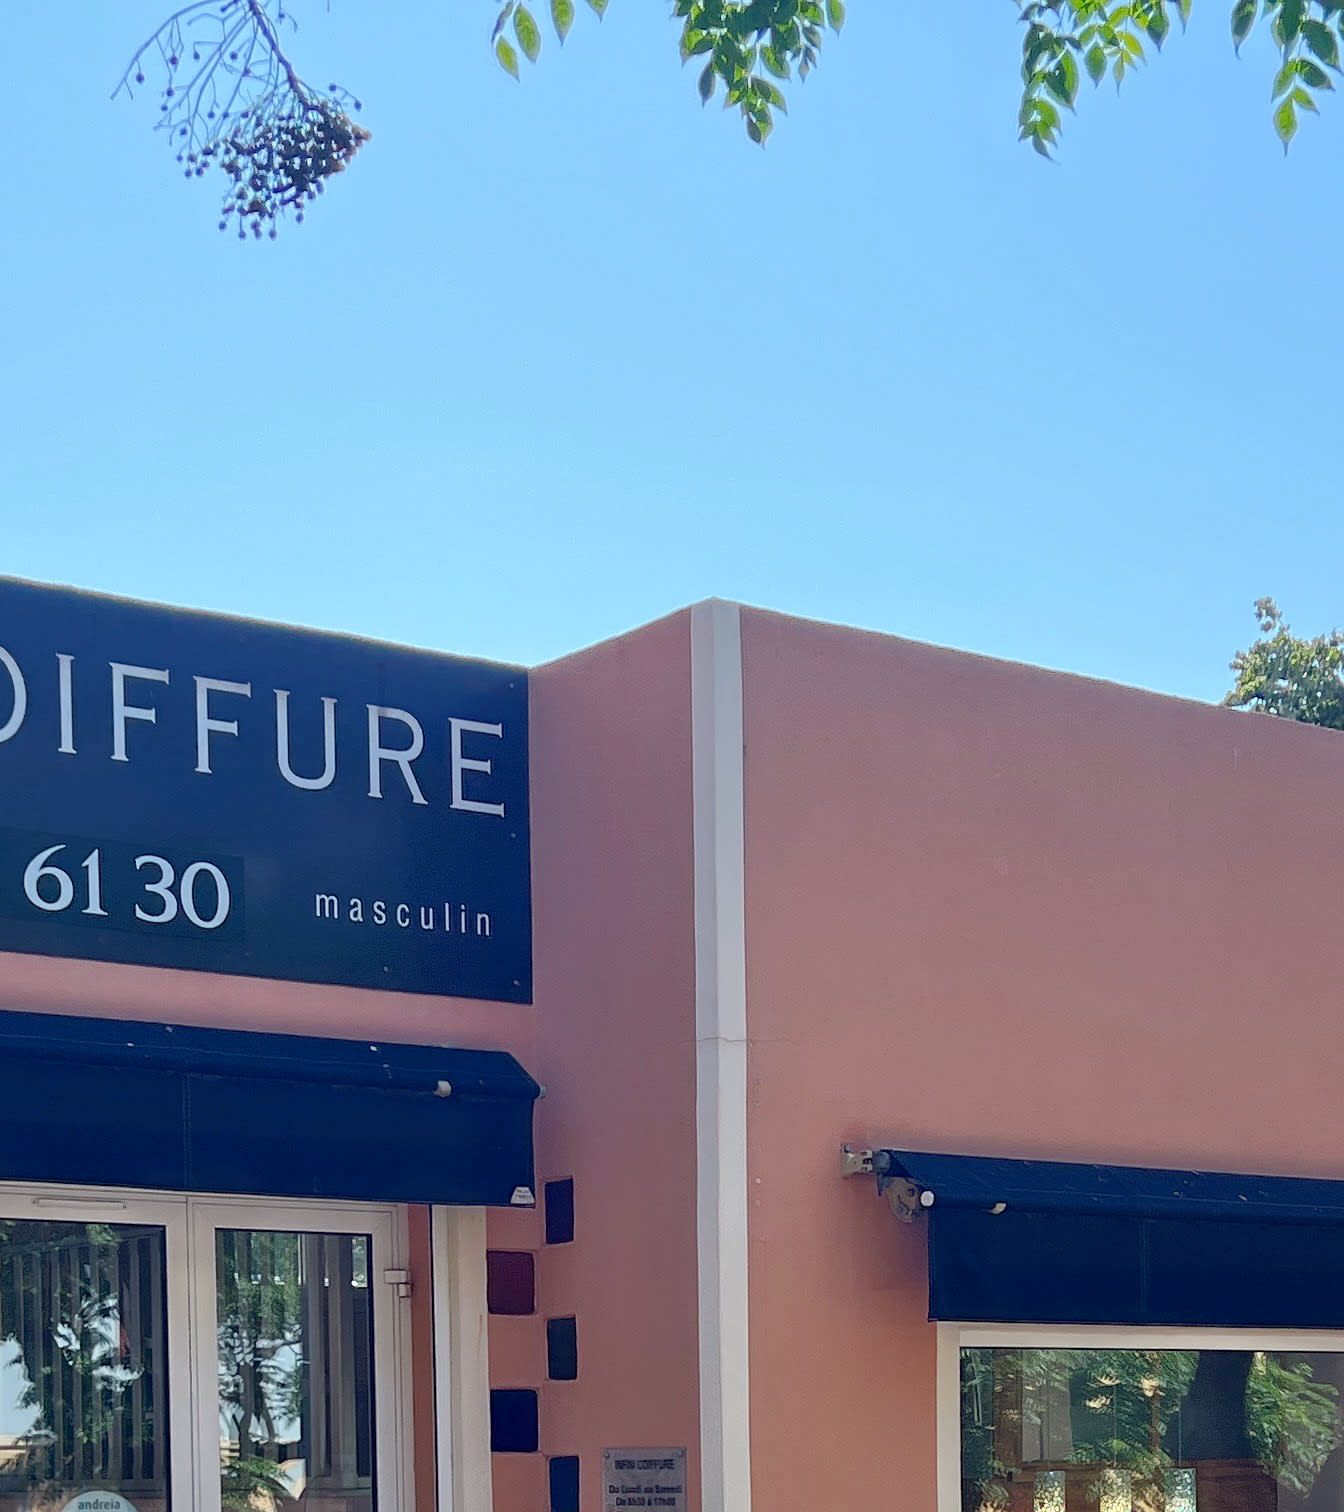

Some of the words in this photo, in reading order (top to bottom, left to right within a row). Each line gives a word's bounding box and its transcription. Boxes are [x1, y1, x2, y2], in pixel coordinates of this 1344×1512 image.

[23, 844, 109, 917] 61
[134, 855, 231, 930] 30
[315, 890, 493, 937] masculin
[77, 1498, 121, 1510] andreia
